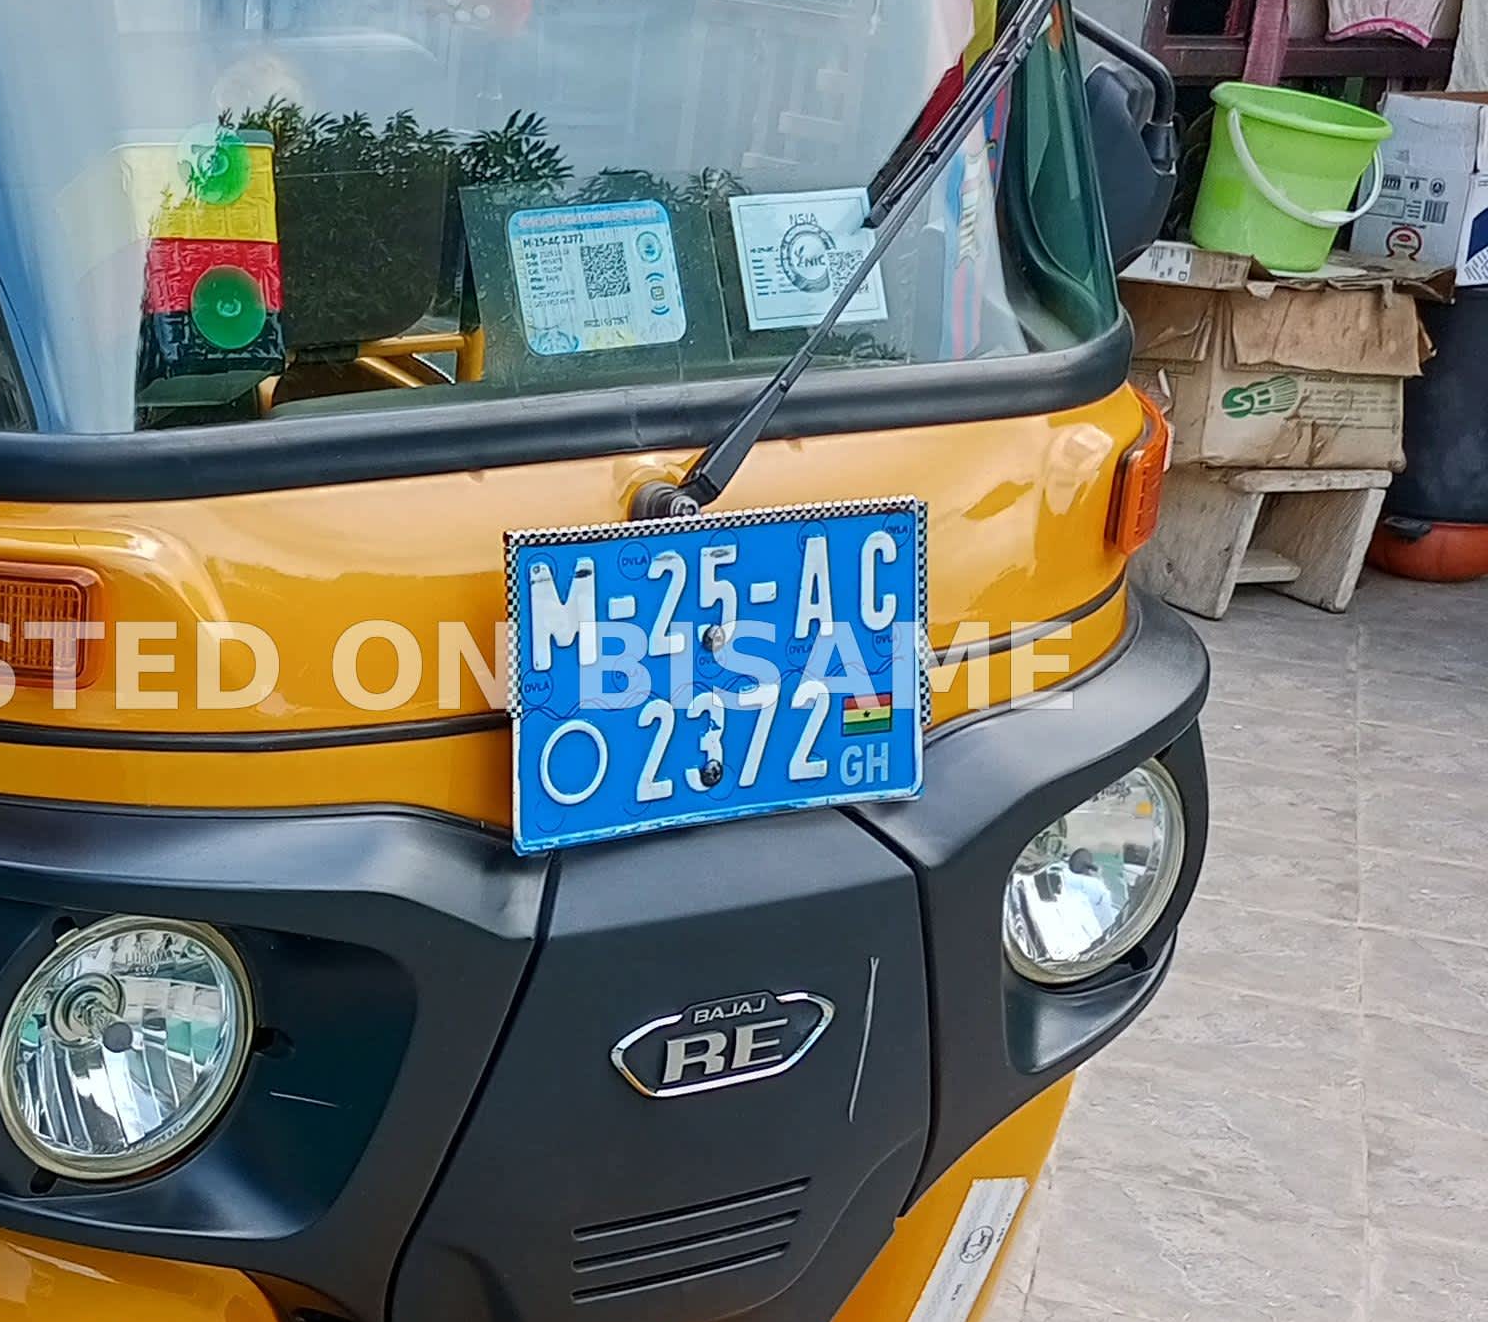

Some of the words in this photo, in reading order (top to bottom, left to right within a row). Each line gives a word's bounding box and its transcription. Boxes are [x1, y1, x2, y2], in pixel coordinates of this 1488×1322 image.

[621, 555, 650, 569] DVLA
[524, 681, 551, 694] DVLA
[636, 679, 831, 803] 2372
[839, 741, 889, 786] GH
[693, 997, 767, 1024] BAJAJ
[661, 1017, 789, 1085] RE
